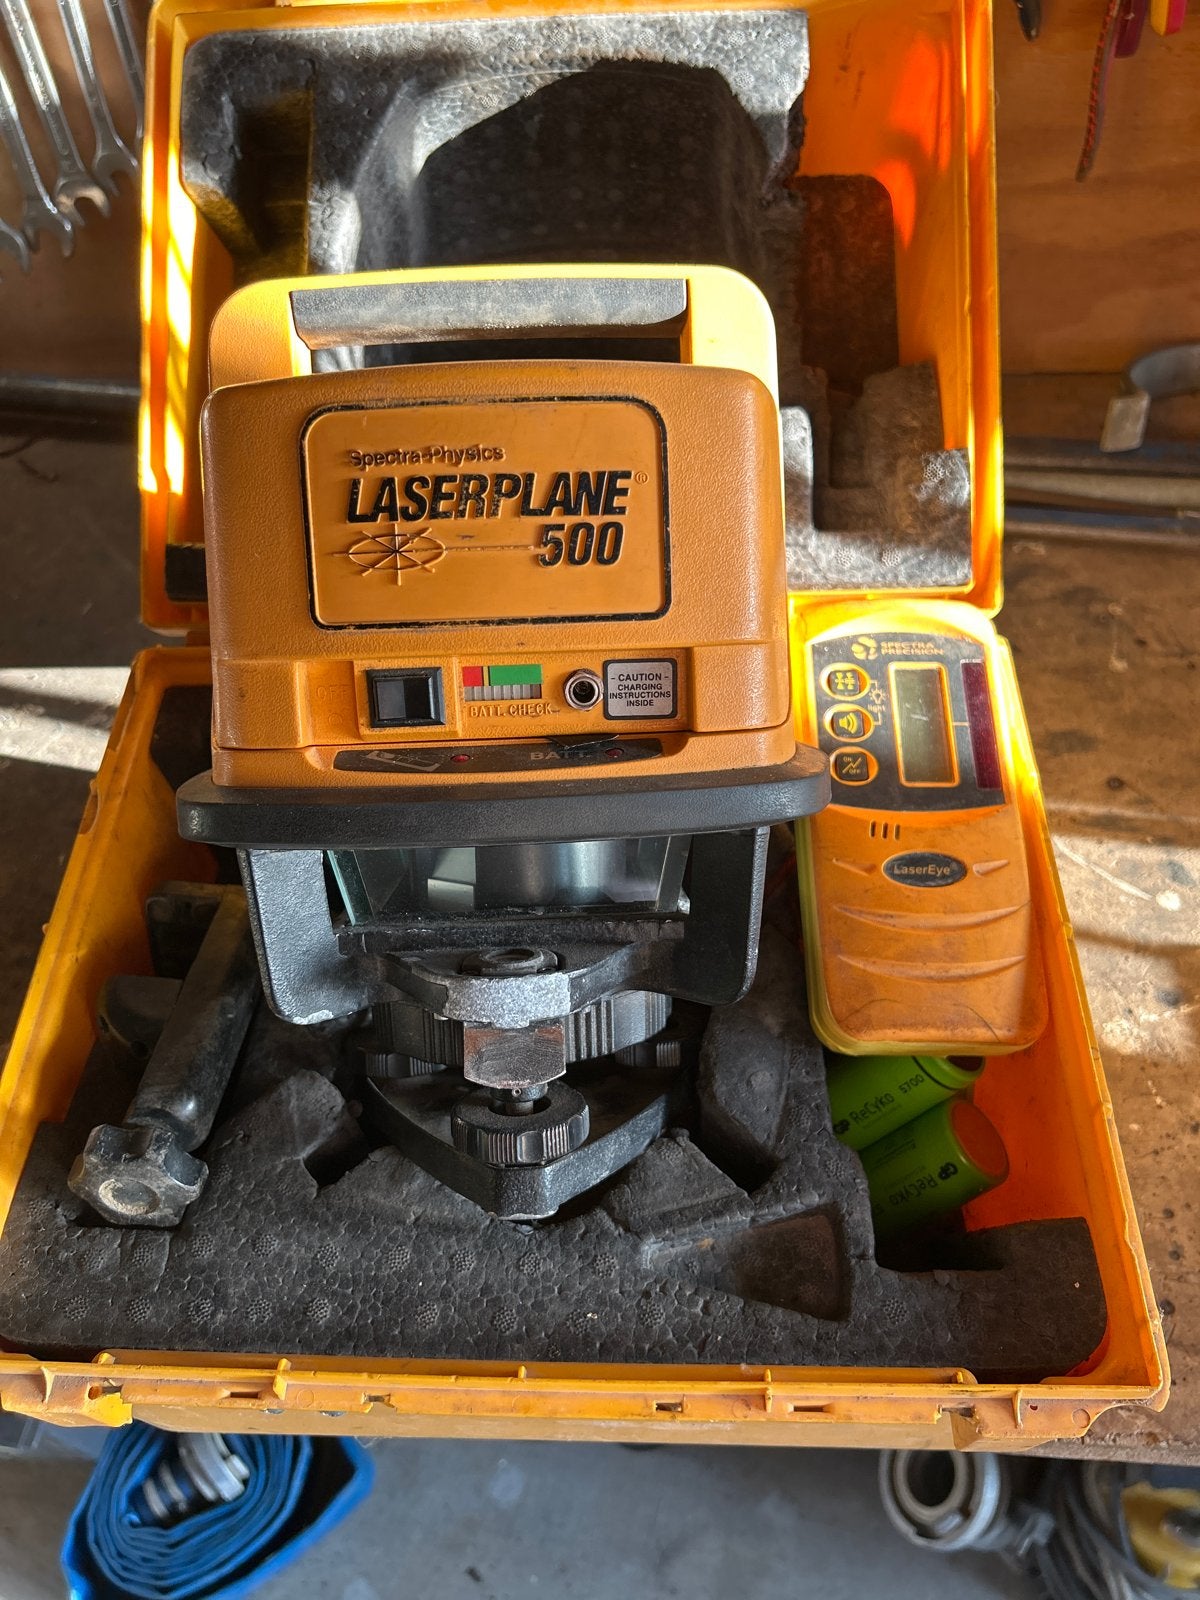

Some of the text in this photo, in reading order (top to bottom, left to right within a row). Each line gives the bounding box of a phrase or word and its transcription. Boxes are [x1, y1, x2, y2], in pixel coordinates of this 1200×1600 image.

[349, 445, 506, 471] Spectra-Physics
[537, 521, 624, 568] 500
[881, 641, 935, 649] SPECTRA
[618, 673, 662, 682] CAUTION
[617, 683, 663, 691] CHARGING
[609, 691, 671, 699] INSTRUCTIONS
[626, 699, 654, 707] INSIDE
[470, 703, 553, 718] BATT. CHECK
[898, 1073, 925, 1094] 5700
[938, 1162, 958, 1181] GP
